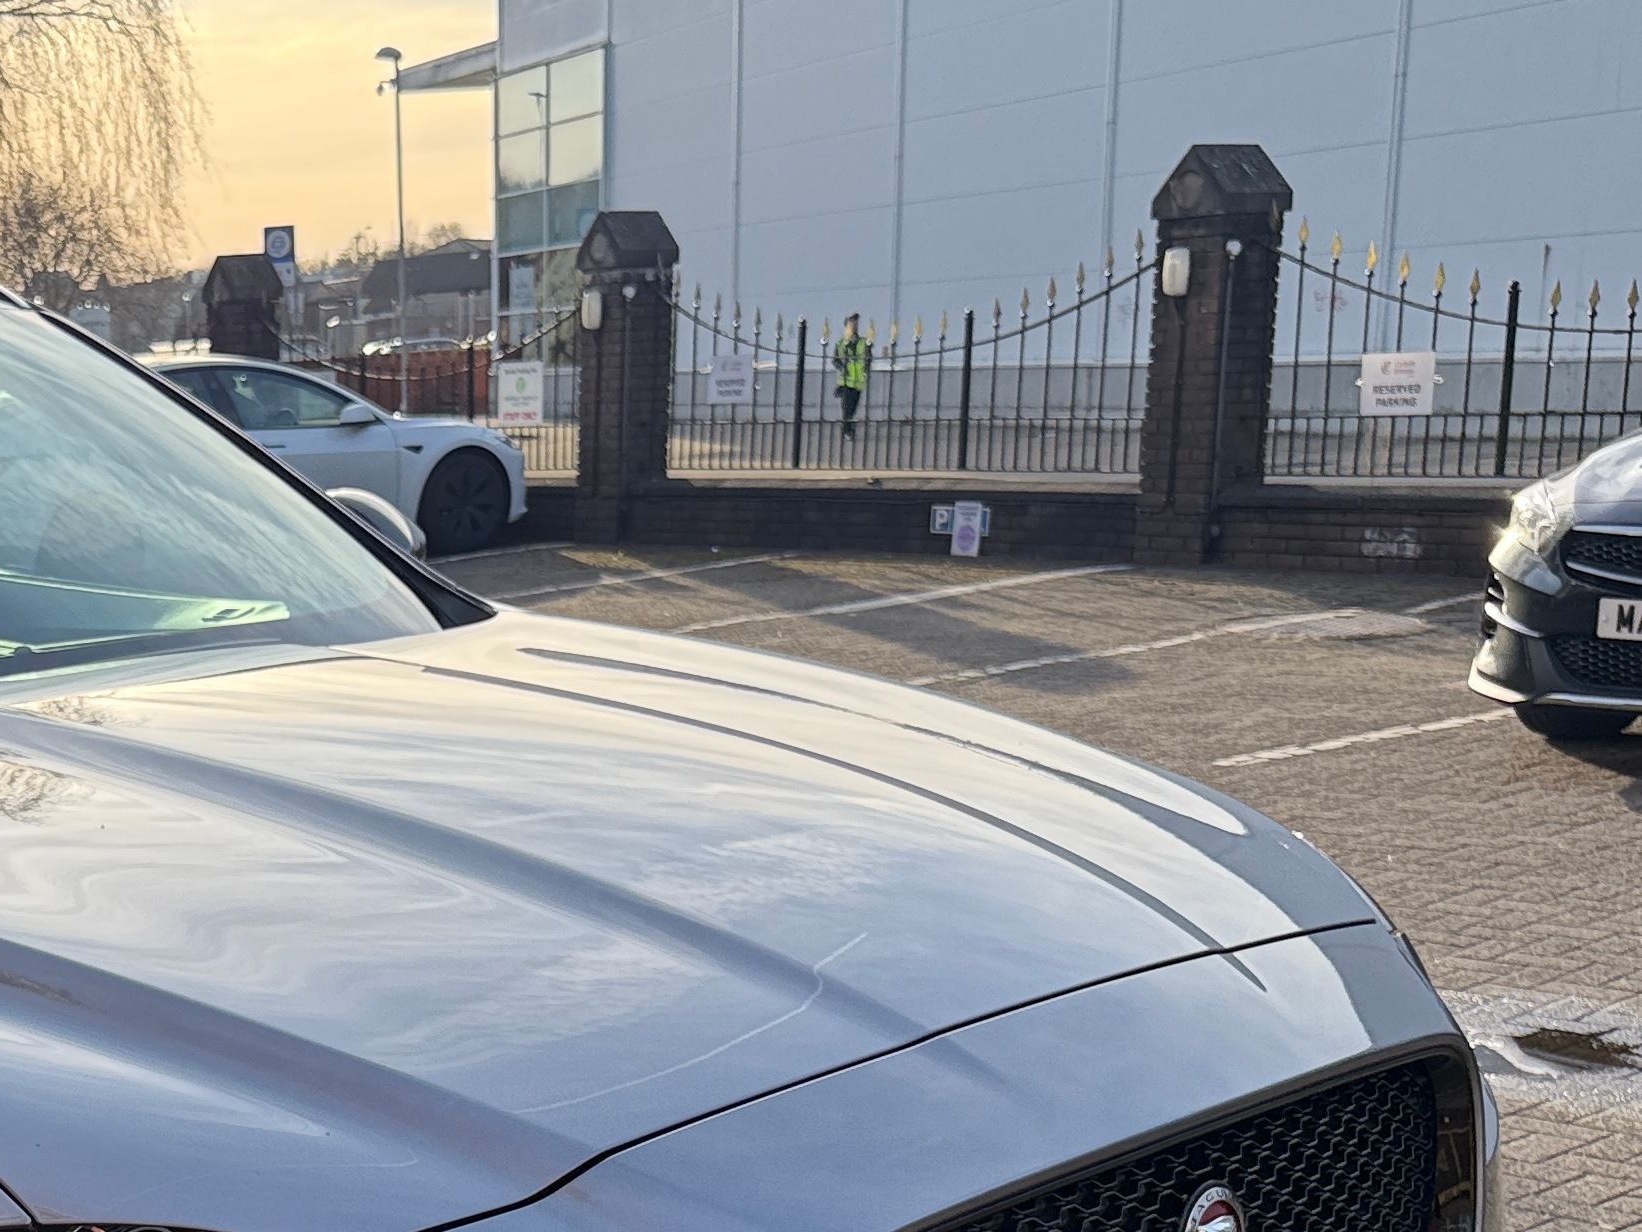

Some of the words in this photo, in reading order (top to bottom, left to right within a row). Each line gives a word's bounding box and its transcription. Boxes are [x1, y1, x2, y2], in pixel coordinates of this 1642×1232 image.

[1372, 383, 1422, 395] RESERVED
[1375, 397, 1418, 408] PARKING
[934, 509, 949, 530] P
[1615, 603, 1642, 634] M
